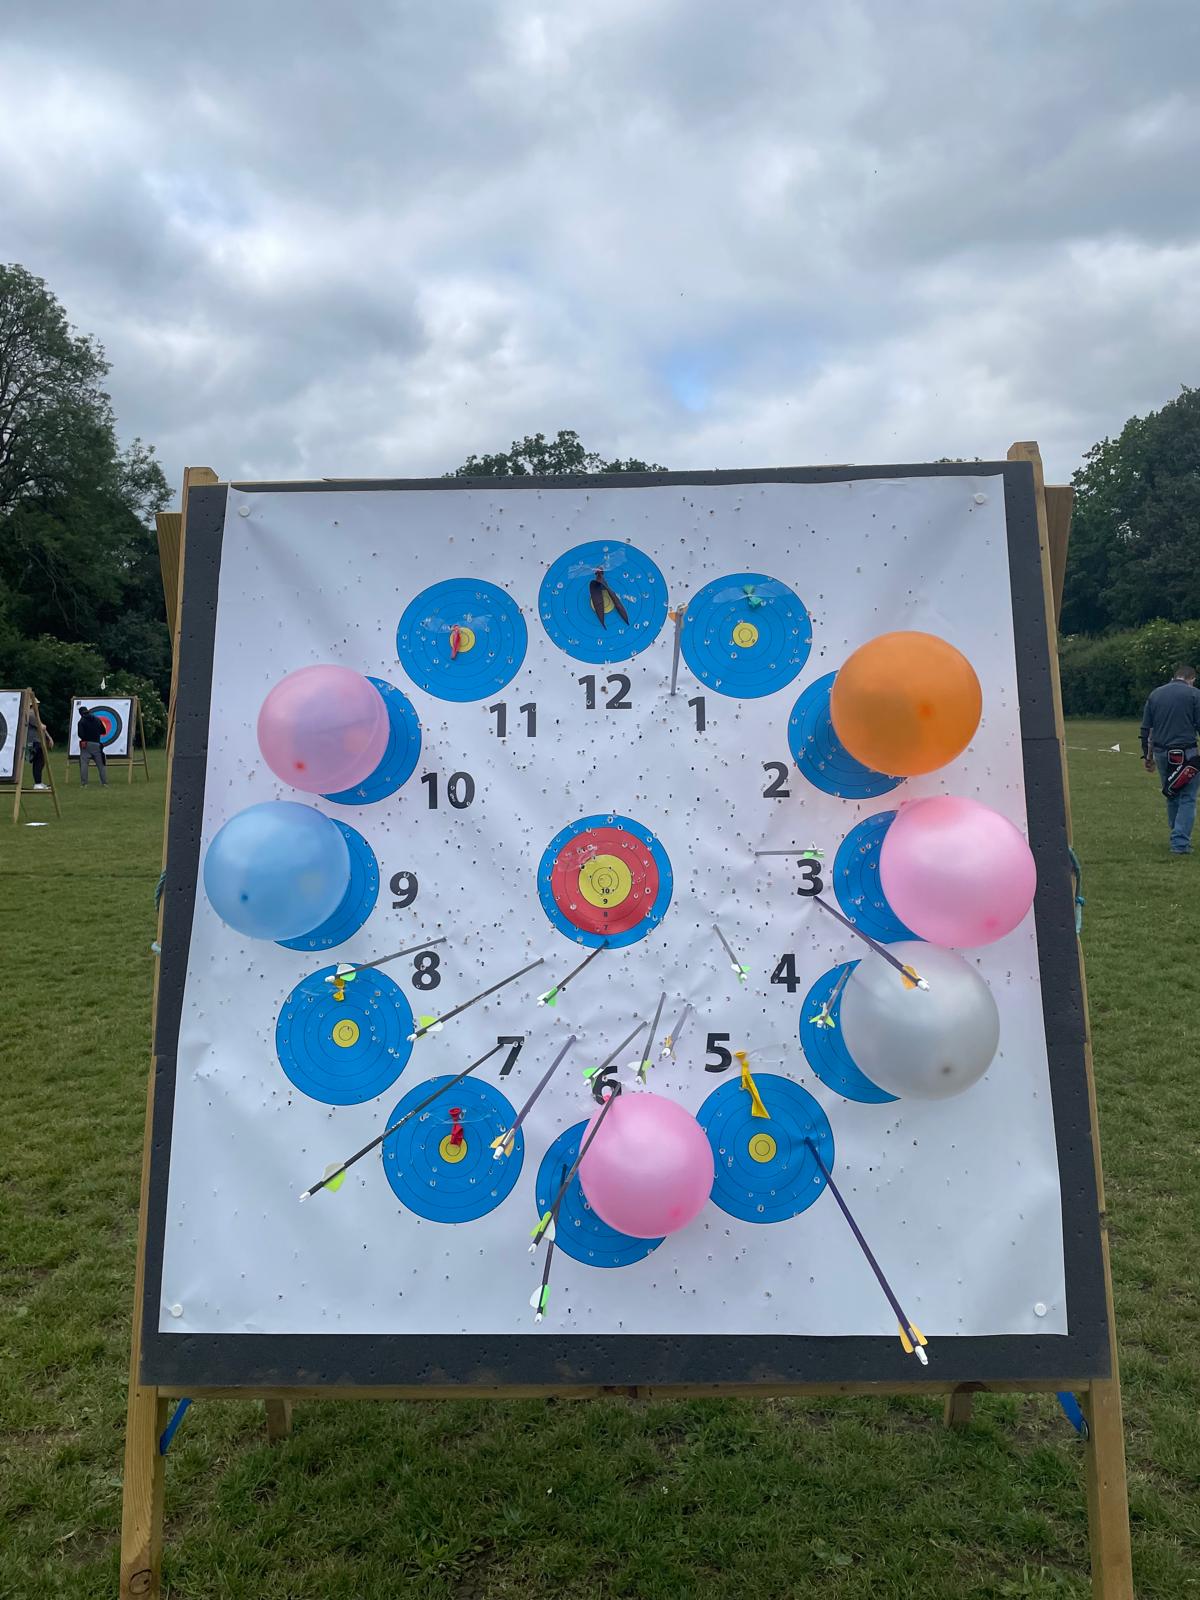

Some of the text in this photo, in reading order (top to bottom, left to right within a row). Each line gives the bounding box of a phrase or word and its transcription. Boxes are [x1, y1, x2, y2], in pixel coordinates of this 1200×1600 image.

[578, 674, 632, 709] 12
[490, 703, 536, 737] 11
[687, 696, 706, 731] 1
[420, 771, 475, 809] 10
[763, 762, 790, 798] 2
[390, 870, 419, 909] 9
[797, 858, 823, 897] 3
[411, 951, 441, 990] 8
[771, 953, 801, 993] 4
[497, 1036, 525, 1076] 7
[704, 1032, 732, 1073] 5
[592, 1065, 622, 1105] 6
